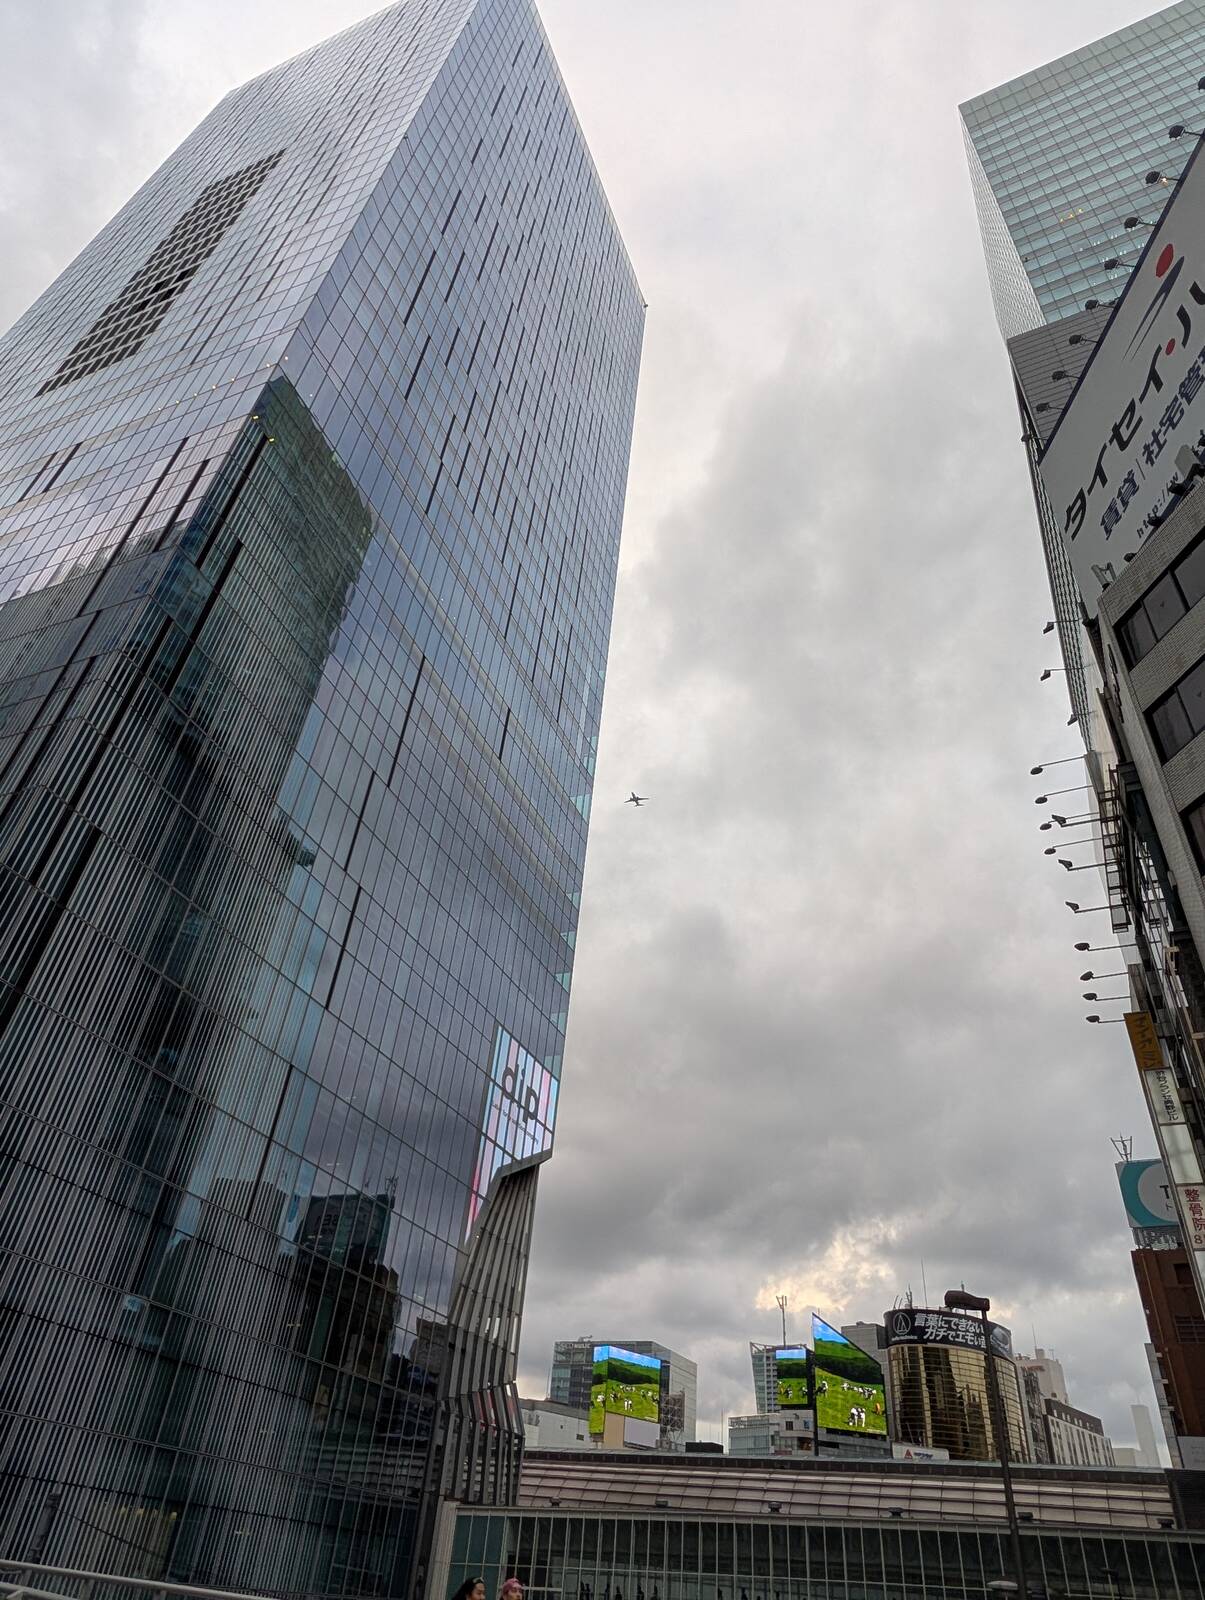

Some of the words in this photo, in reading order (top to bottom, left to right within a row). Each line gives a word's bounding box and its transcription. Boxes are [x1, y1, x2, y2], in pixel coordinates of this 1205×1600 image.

[1100, 468, 1140, 541] 賃貸
[1142, 345, 1205, 467] 社宅管
[502, 1063, 539, 1124] dip
[914, 1313, 985, 1334] 言葉にできない
